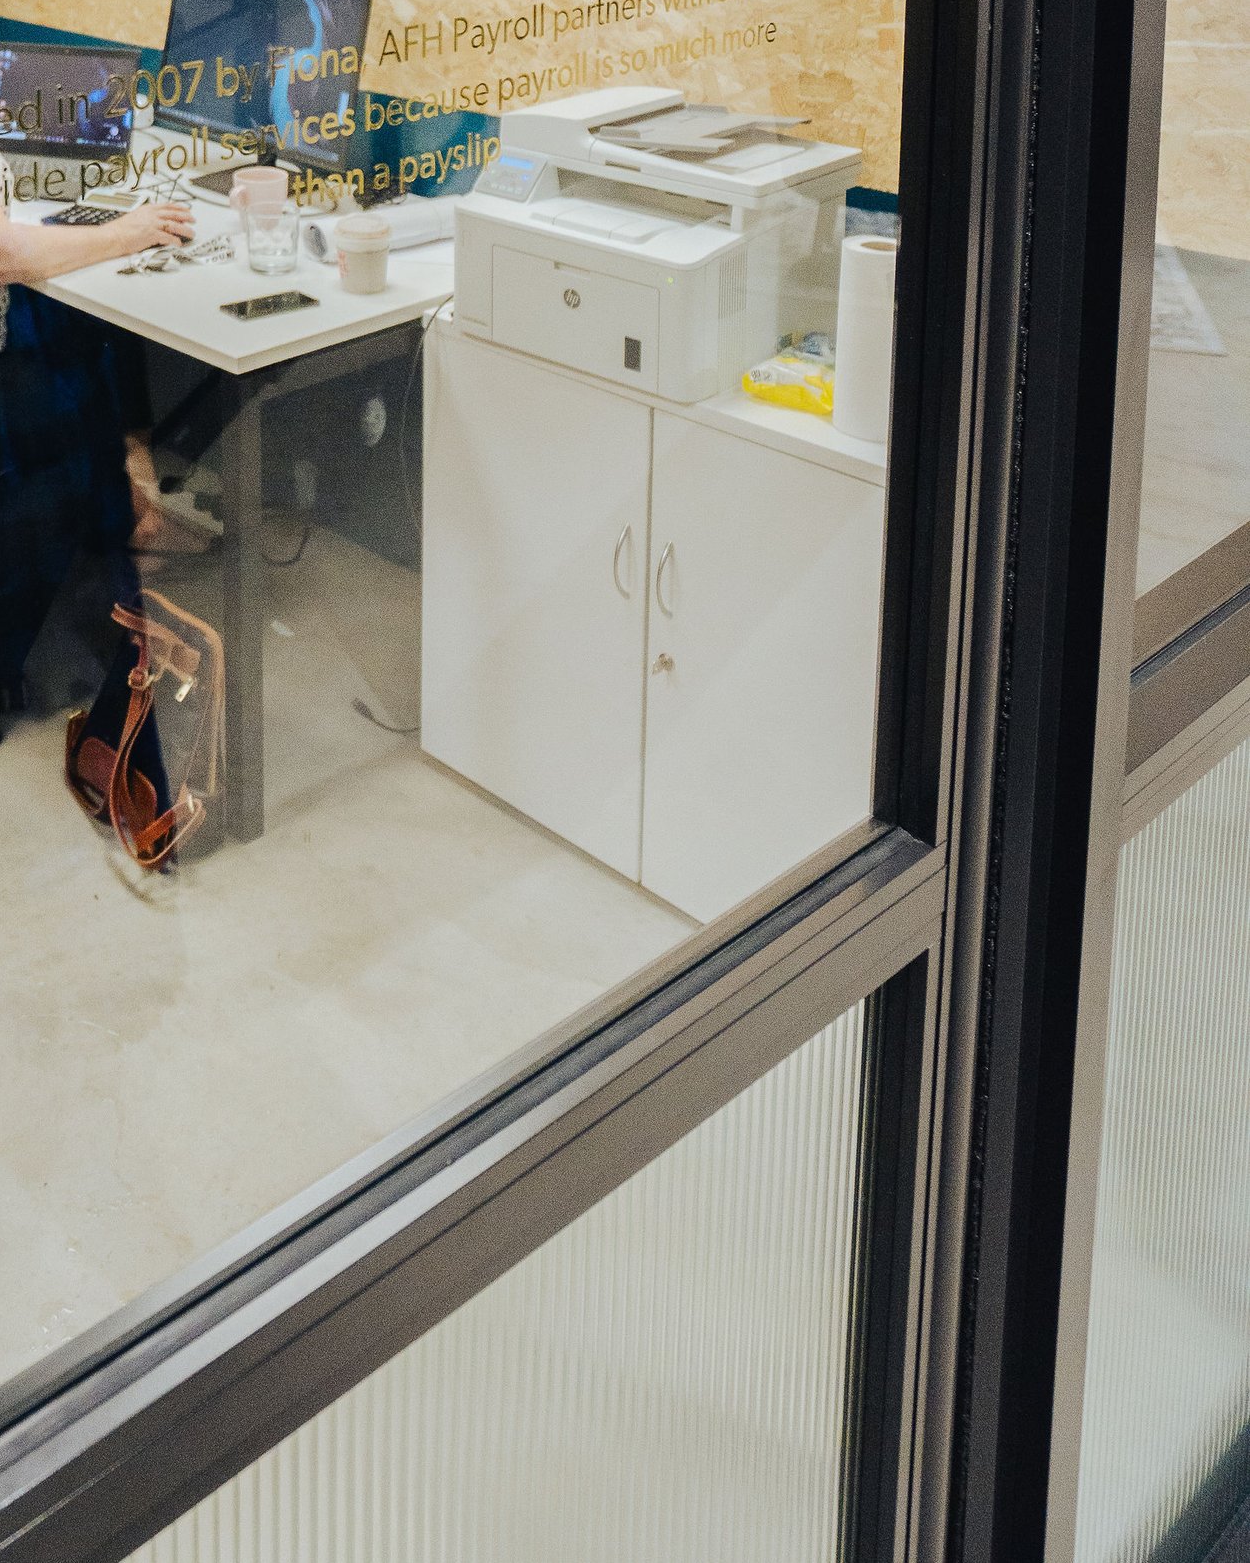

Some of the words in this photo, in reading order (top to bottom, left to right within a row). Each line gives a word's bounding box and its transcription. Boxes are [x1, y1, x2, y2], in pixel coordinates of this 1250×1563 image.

[56, 83, 91, 125] in
[105, 60, 205, 119] 2007
[216, 56, 260, 104] by
[379, 20, 443, 67] AFH
[453, 2, 546, 55] Payroll
[81, 125, 209, 201] payroll
[220, 106, 356, 160] services
[364, 81, 490, 132] because
[498, 50, 588, 112] payroll
[595, 50, 614, 81] is
[619, 49, 648, 75] so
[653, 26, 717, 68] much
[721, 21, 778, 54] more
[293, 165, 366, 208] than
[373, 162, 391, 190] a
[399, 132, 501, 190] payslip
[564, 288, 581, 309] hp
